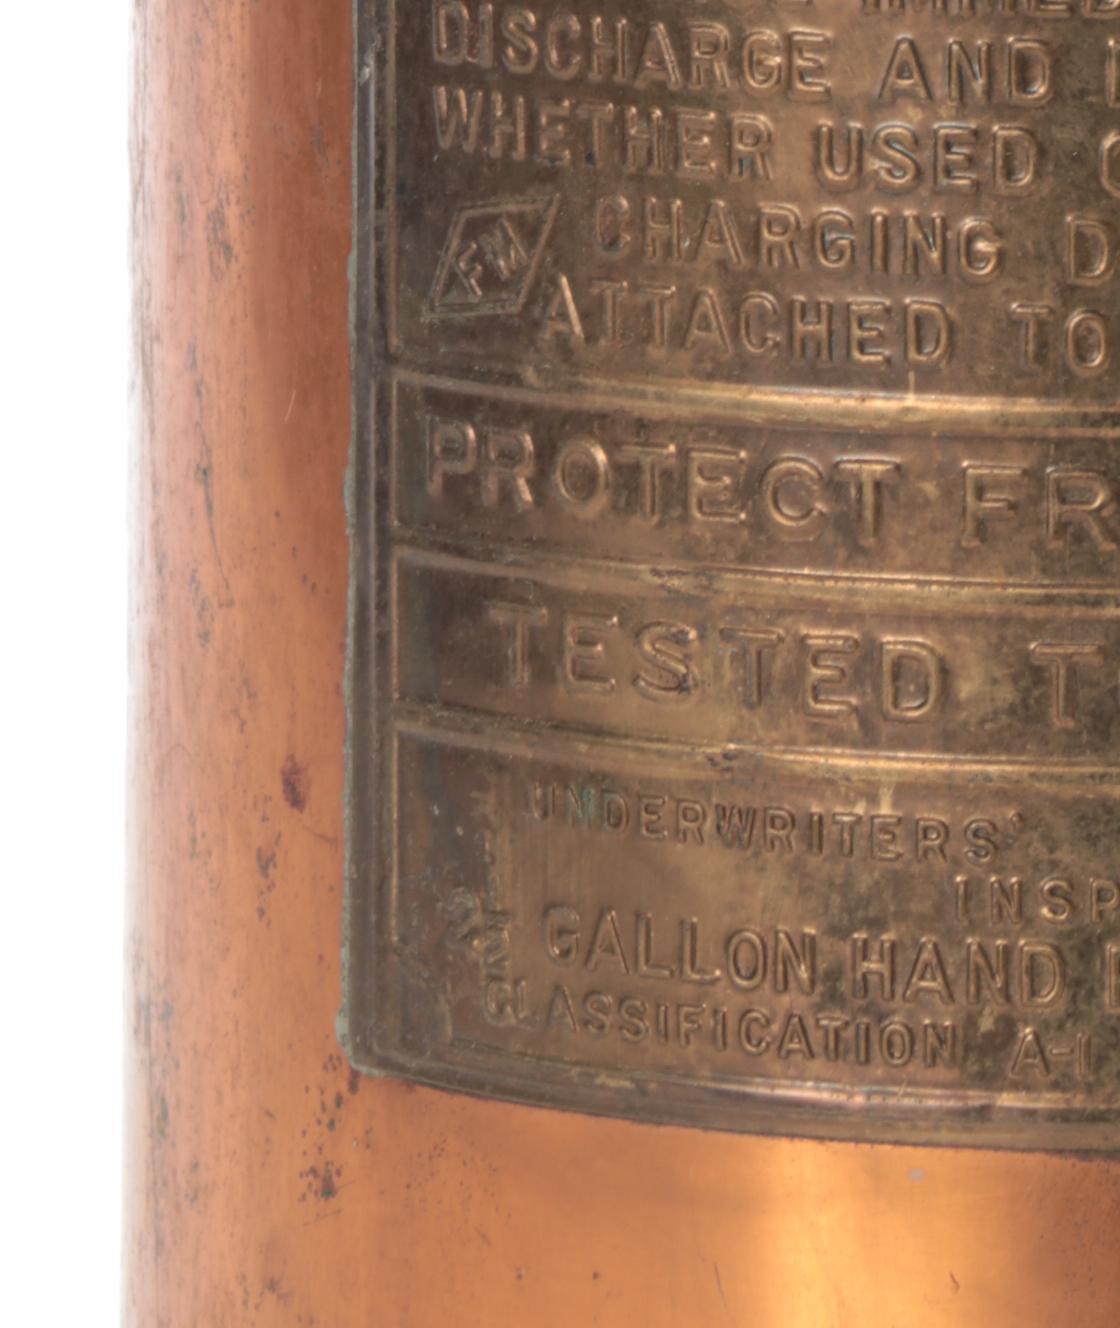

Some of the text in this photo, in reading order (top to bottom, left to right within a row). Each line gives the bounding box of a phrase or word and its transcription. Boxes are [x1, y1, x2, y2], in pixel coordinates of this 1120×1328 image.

[879, 36, 1057, 107] AND
[431, 85, 773, 181] WHETHER
[816, 120, 1039, 193] USED
[595, 195, 1001, 284] CHARGING
[539, 275, 953, 368] ATTACHED
[1009, 301, 1109, 376] TO
[426, 415, 900, 540] PROTECT
[489, 601, 943, 733] TESTED
[544, 903, 818, 995] GALLON
[850, 936, 1068, 1010] HAND
[482, 978, 960, 1067] CLASSIFICATION
